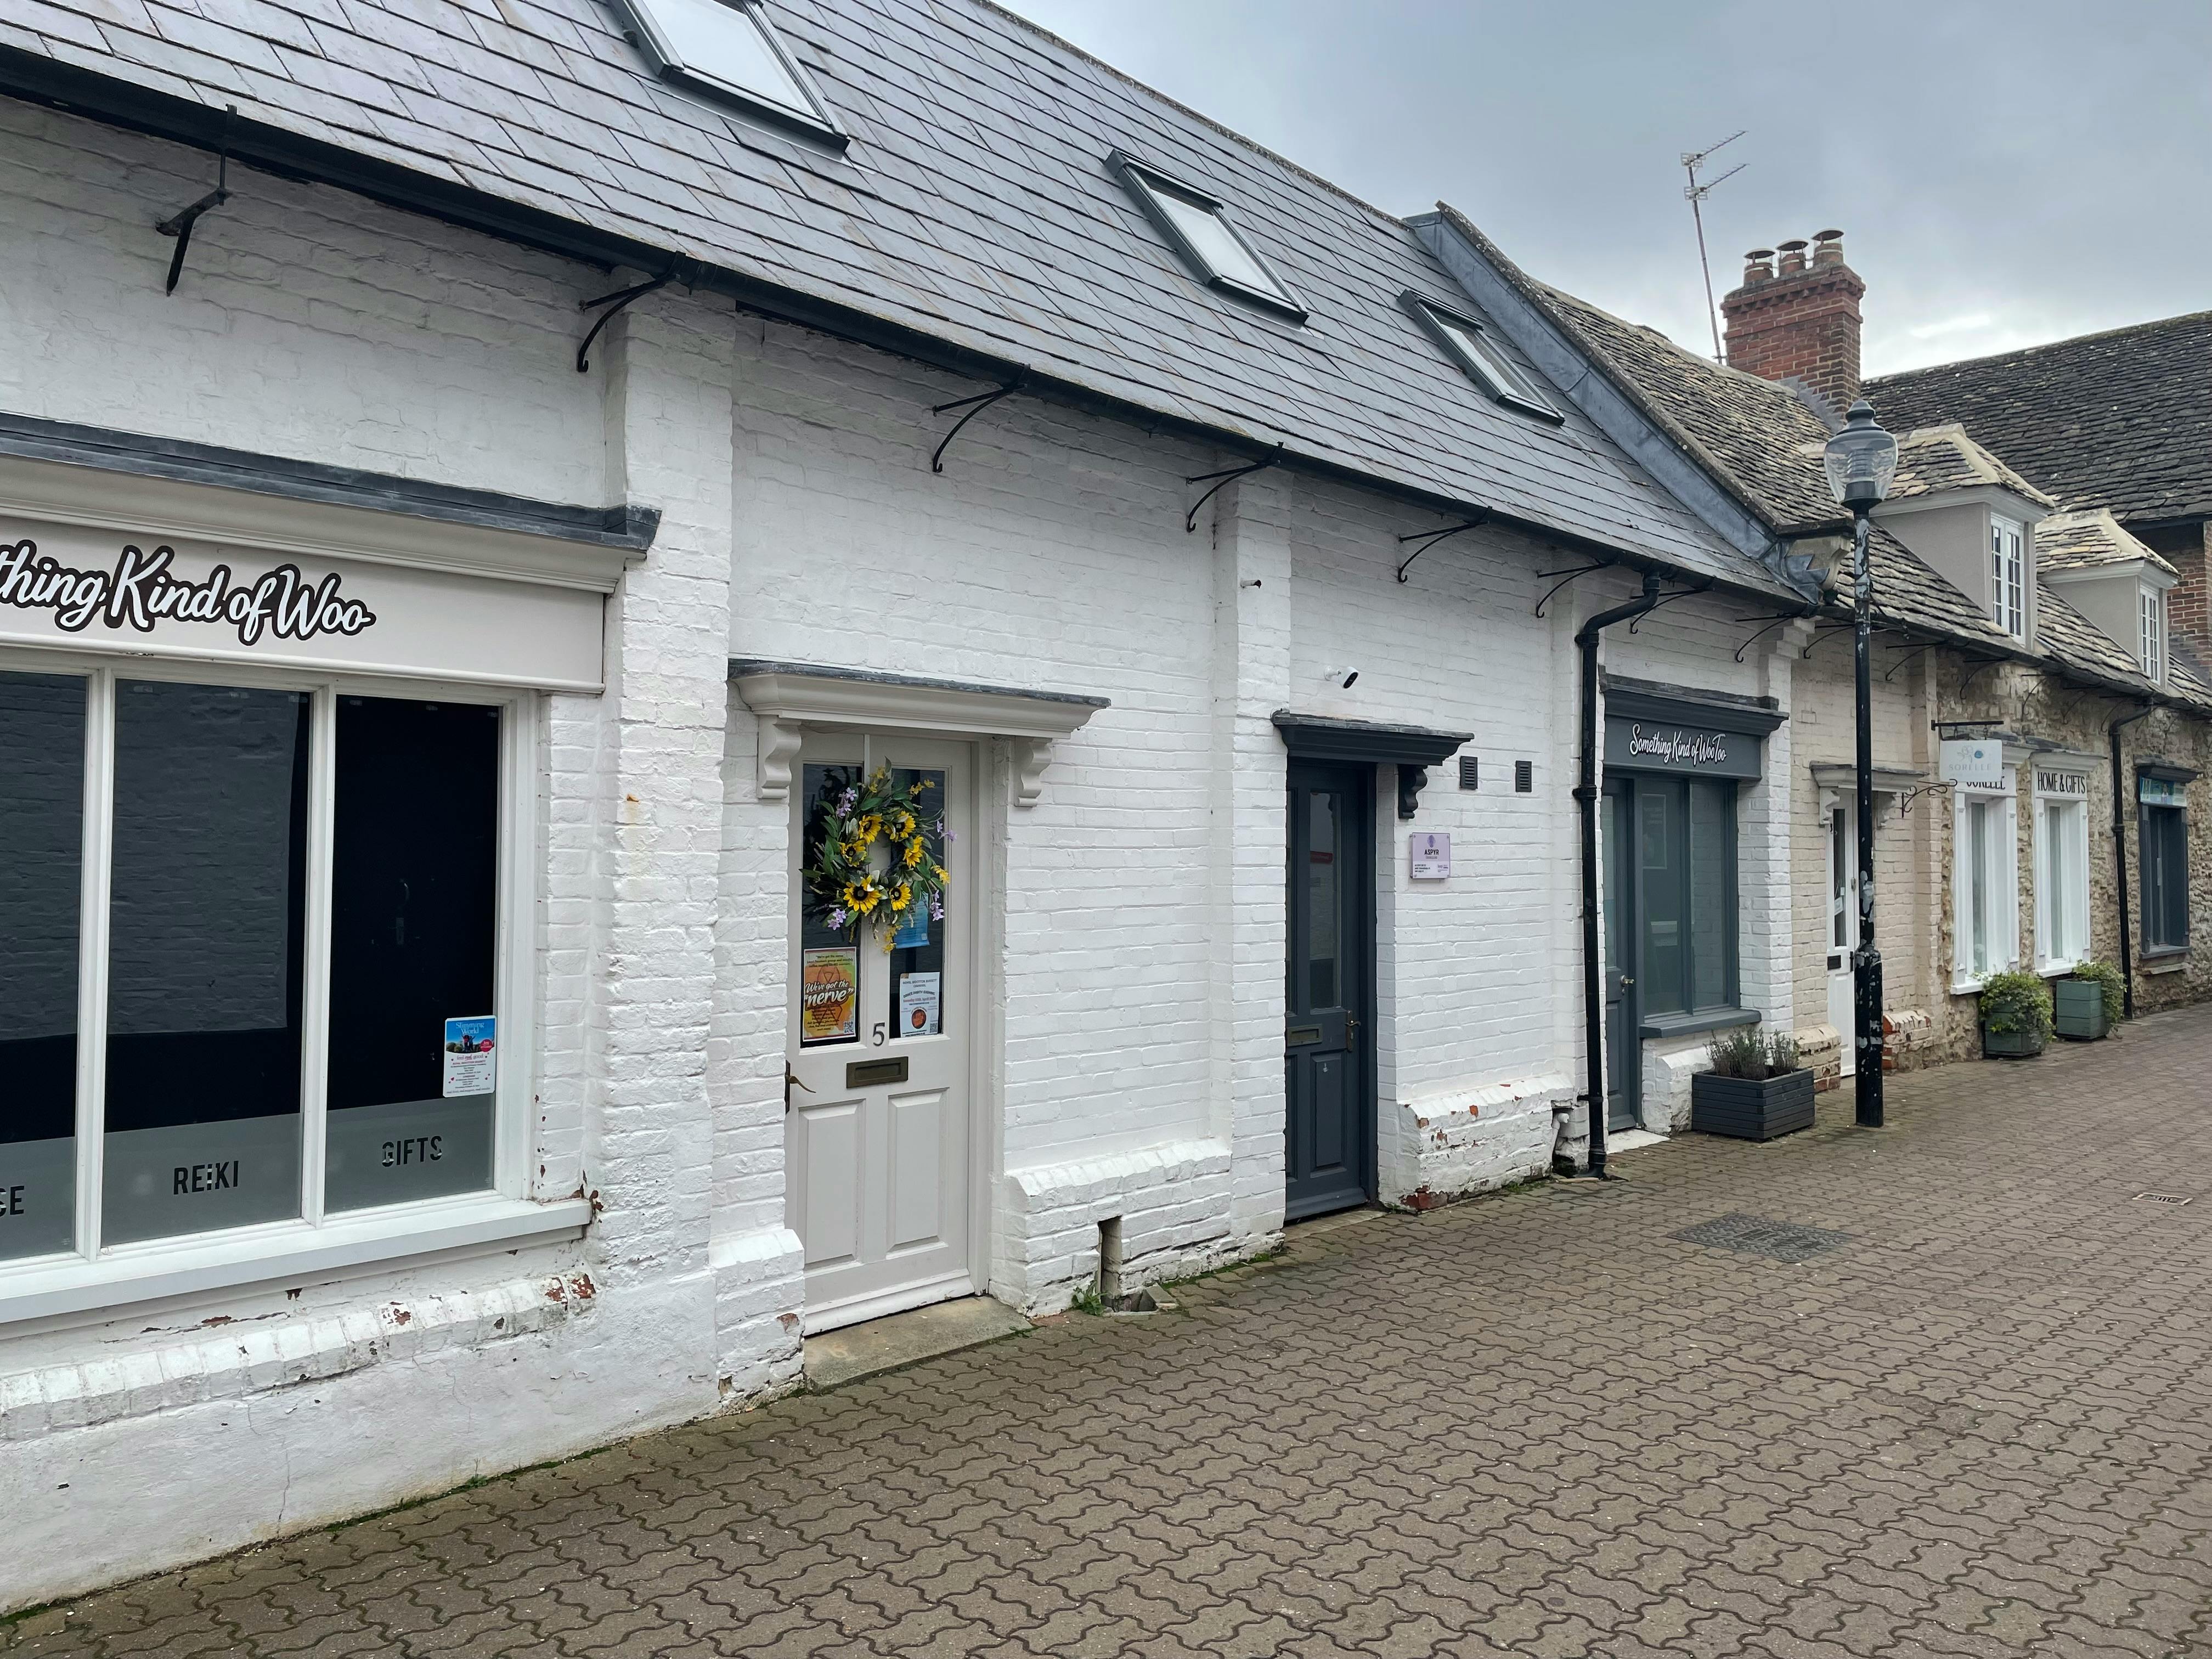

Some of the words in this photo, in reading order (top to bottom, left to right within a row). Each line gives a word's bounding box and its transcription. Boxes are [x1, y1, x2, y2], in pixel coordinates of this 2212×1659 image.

[110, 549, 225, 629] Kind
[228, 576, 273, 642] of
[275, 568, 373, 637] Woo
[1629, 723, 1672, 763] Something
[1672, 730, 1691, 763] Kind
[1691, 737, 1700, 765] of
[1699, 733, 1714, 762] Woo
[1712, 733, 1726, 762] Too
[2038, 771, 2058, 792] HOME
[2059, 774, 2066, 792] &
[2066, 774, 2086, 794] GIFTS
[805, 981, 825, 993] We've
[825, 981, 838, 992] got
[839, 979, 849, 988] the
[872, 1022, 885, 1047] 5
[382, 1136, 442, 1167] GIFTS
[173, 1160, 239, 1195] REIKI
